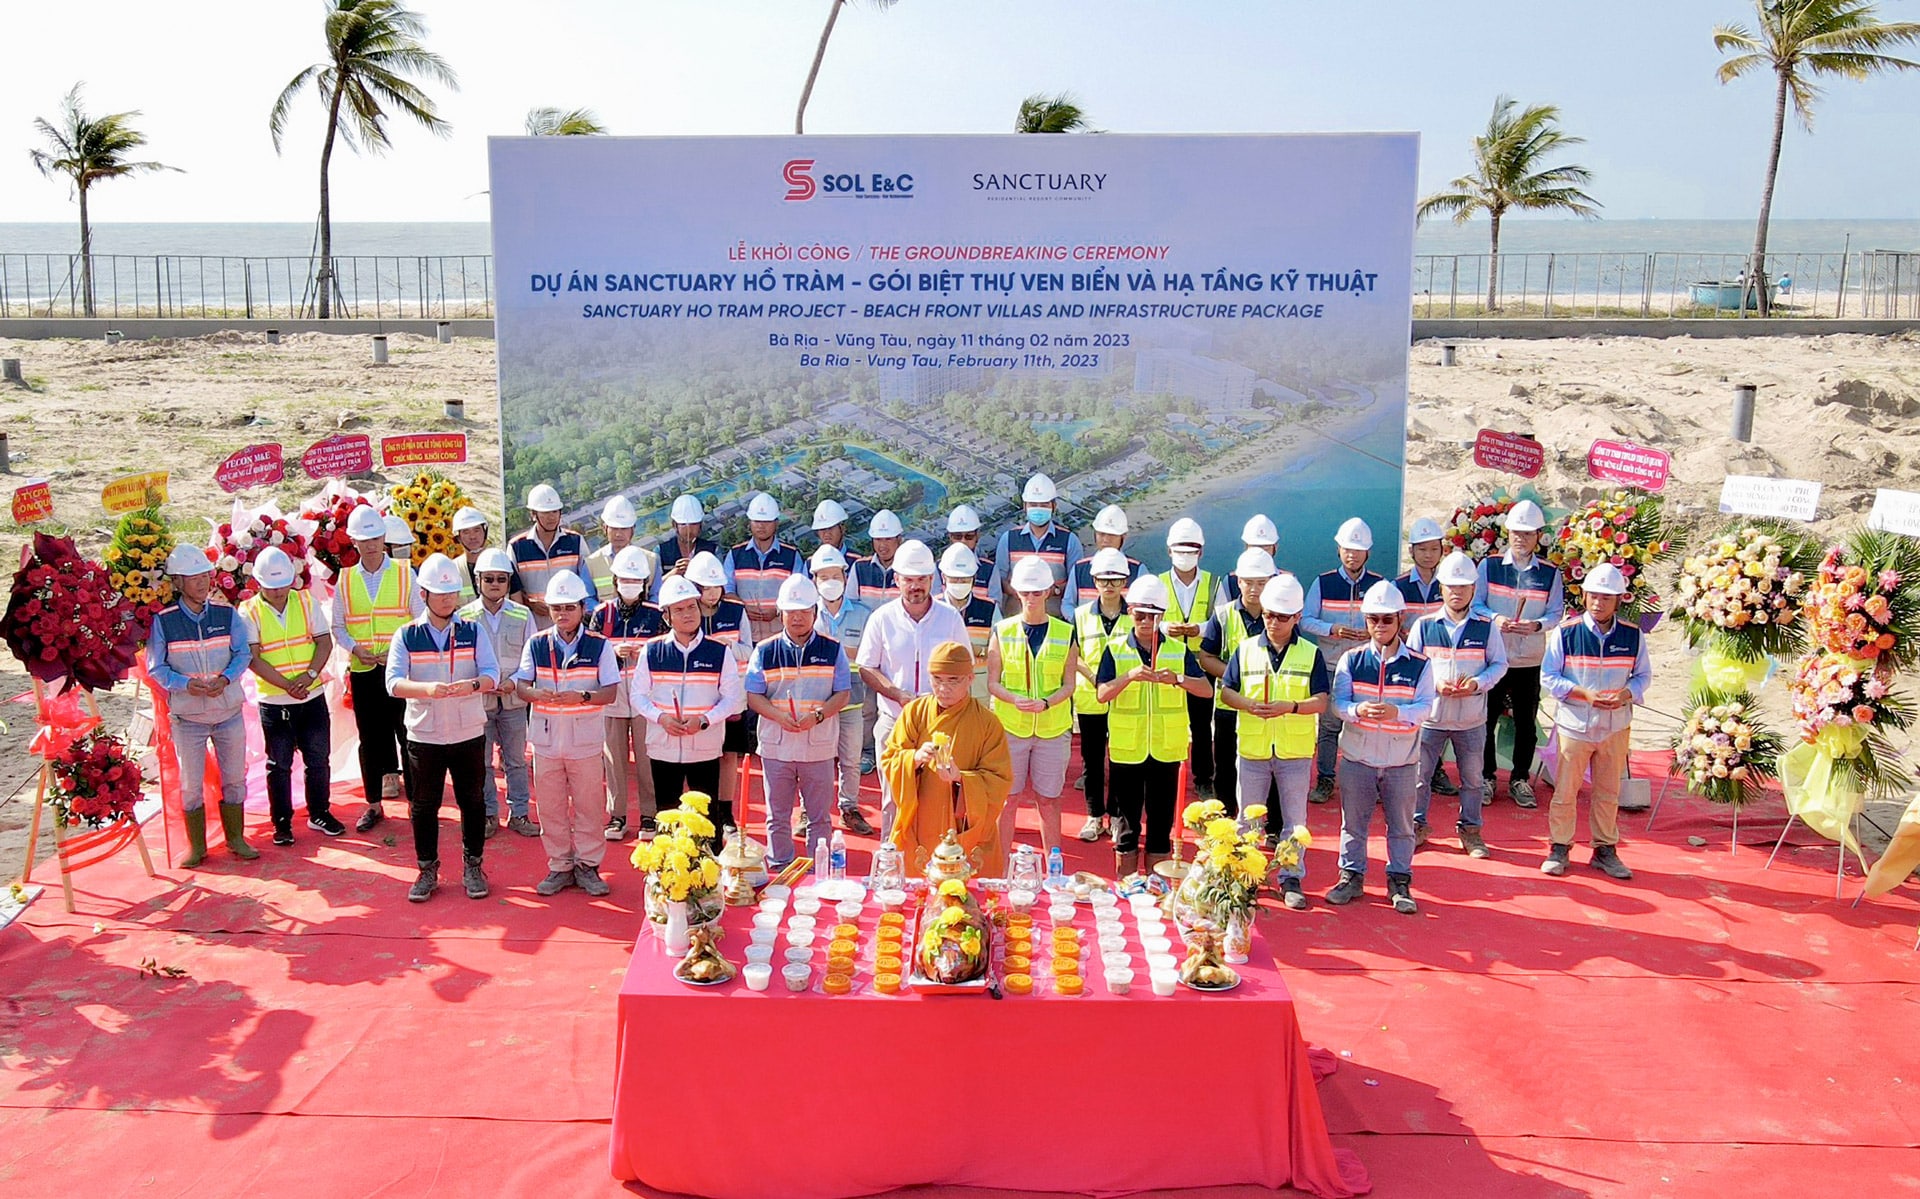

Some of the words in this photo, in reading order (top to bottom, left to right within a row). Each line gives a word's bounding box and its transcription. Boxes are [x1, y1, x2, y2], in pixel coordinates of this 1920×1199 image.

[823, 174, 865, 193] SOL
[872, 174, 914, 193] E&C
[973, 173, 1107, 193] SANCTUARY
[729, 240, 747, 261] LỄ
[751, 243, 792, 261] KHỞI
[797, 243, 850, 261] CÔNG
[870, 246, 901, 260] THE
[904, 246, 1068, 261] GROUNDBREAKING
[1073, 246, 1170, 261] CEREMONY
[531, 273, 563, 298] DỰ
[568, 269, 598, 292] ÁN
[605, 273, 737, 292] SANCTUARY
[744, 267, 777, 292] HỒ
[783, 268, 844, 292] TRÀM
[869, 268, 912, 292] GÓI
[919, 268, 965, 297] BIỆT
[970, 272, 1016, 297] THỰ
[1021, 273, 1064, 292] VEN
[1071, 267, 1120, 292] BIỂN
[1126, 268, 1157, 292] VÀ
[1164, 273, 1195, 297] HẠ
[1200, 267, 1264, 292] TẦNG
[1271, 268, 1300, 292] KỸ
[1306, 268, 1379, 297] THUẬT
[583, 303, 683, 319] SANCTUARY
[687, 304, 713, 318] HO
[718, 304, 764, 318] TRAM
[768, 304, 847, 318] PROJECT
[864, 304, 921, 318] BEACH
[925, 304, 983, 318] FRONT
[988, 304, 1043, 318] VILLAS
[1047, 304, 1085, 318] AND
[1089, 304, 1238, 318] INFRASTRUCTURE
[1242, 304, 1325, 318] PACKAGE
[769, 333, 789, 347] Bà
[794, 333, 819, 350] Rịa
[835, 333, 876, 350] Vũng
[880, 333, 912, 349] Tàu,
[917, 333, 957, 350] ngày
[961, 334, 973, 347] 11
[978, 333, 1025, 350] tháng
[1030, 334, 1049, 347] 02
[1054, 334, 1088, 347] năm
[1092, 334, 1130, 347] 2023
[800, 354, 821, 367] Ba
[825, 354, 850, 367] Ria
[867, 354, 907, 370] Vung
[911, 354, 942, 369] Tau,
[947, 354, 1019, 370] February
[1024, 354, 1055, 369] 11th,
[1060, 354, 1099, 368] 2023
[226, 455, 253, 469] TECON
